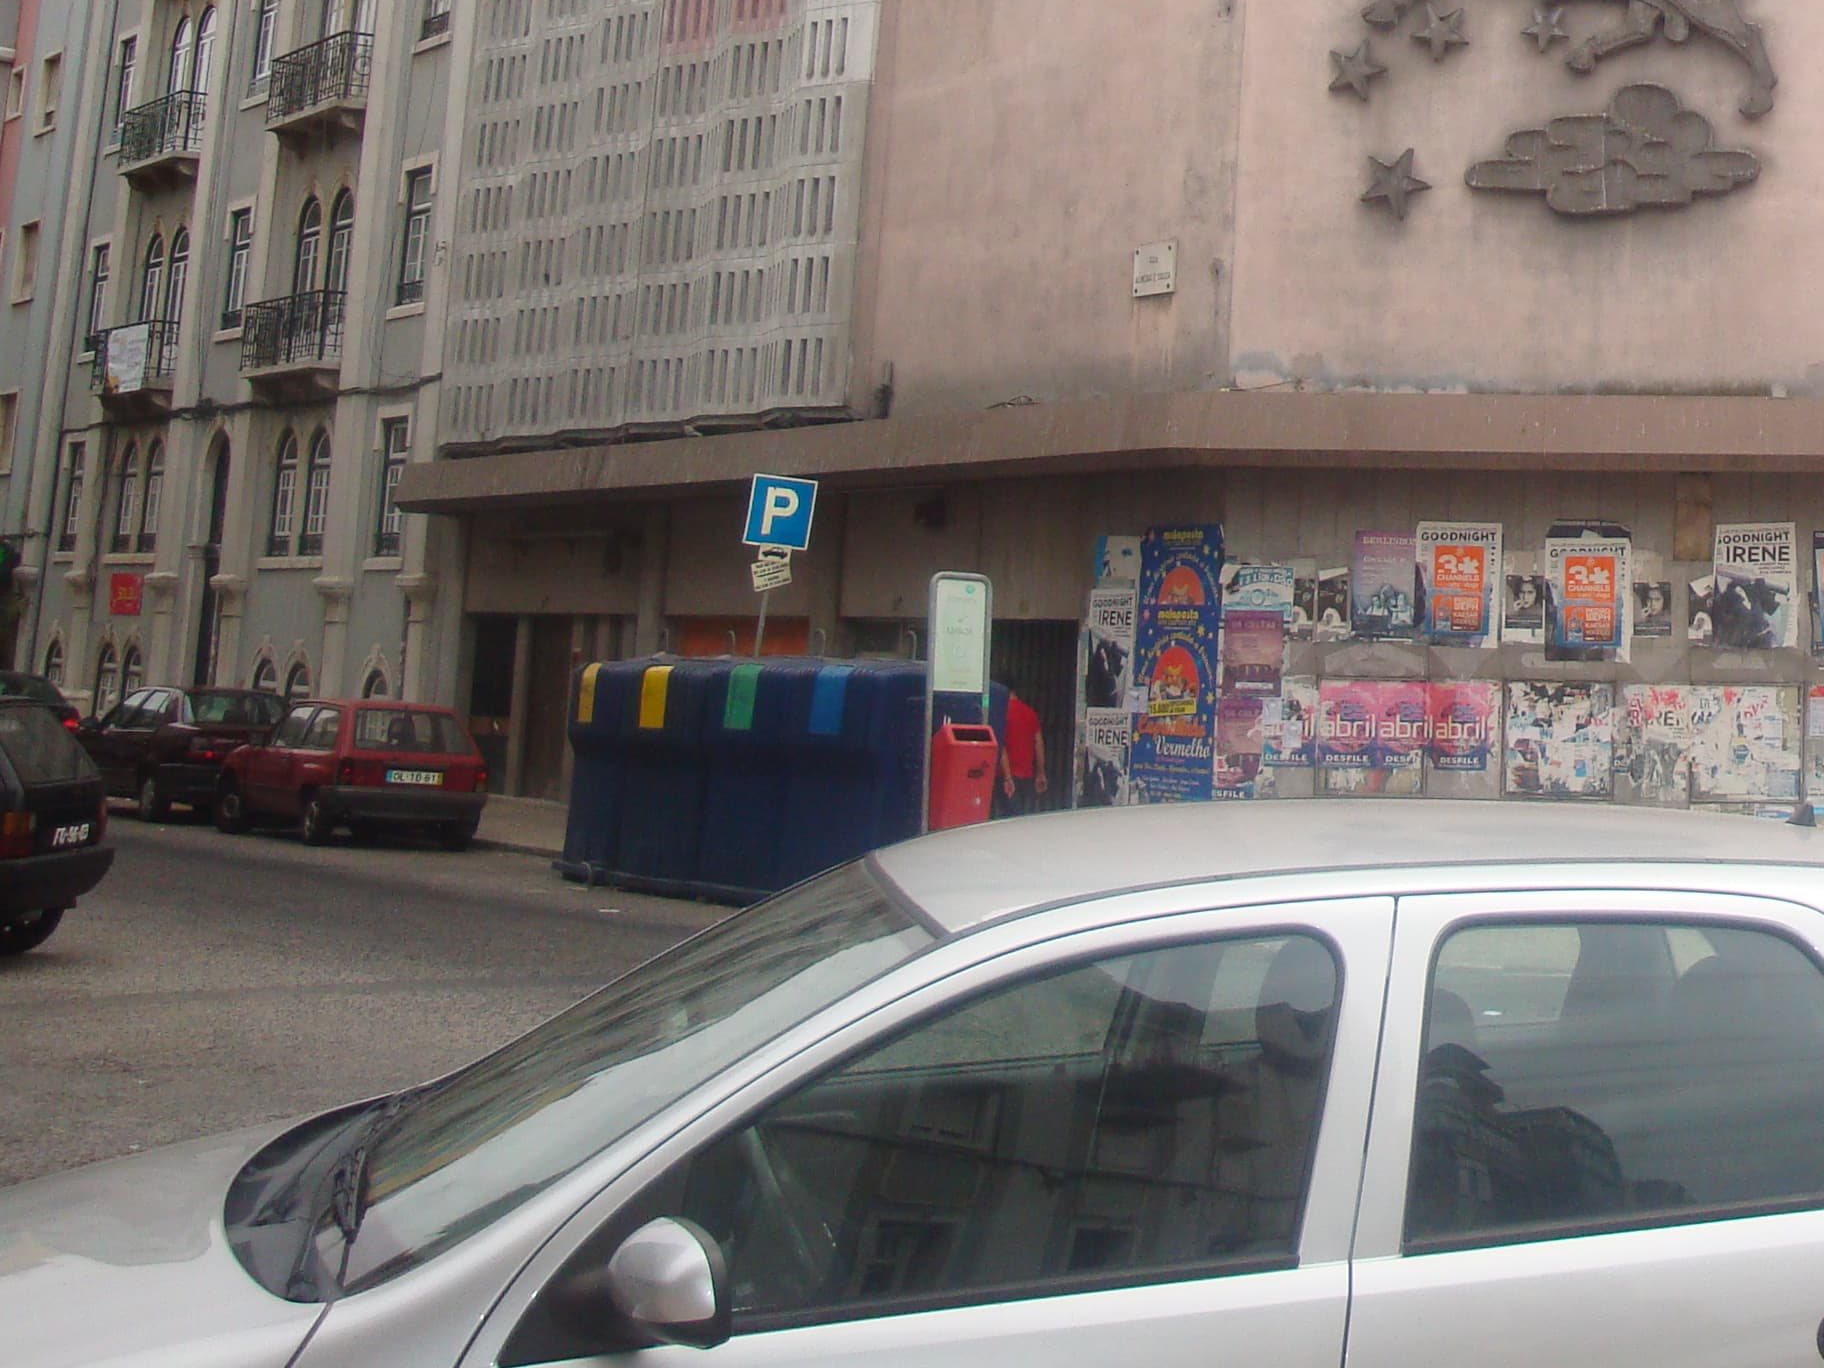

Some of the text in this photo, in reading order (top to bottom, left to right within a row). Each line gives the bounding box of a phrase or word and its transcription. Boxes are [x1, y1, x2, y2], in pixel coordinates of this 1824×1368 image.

[761, 487, 799, 535] P
[1421, 531, 1497, 543] GOODNIGHT
[1726, 545, 1791, 563] IRENE
[1092, 597, 1134, 609] GOODNIGHT
[1098, 610, 1133, 626] IRENE
[1088, 716, 1129, 727] GOODNIGHT
[1320, 714, 1376, 738] abril
[1379, 714, 1433, 739] abril
[1436, 714, 1486, 740] abril
[1094, 728, 1129, 746] IRENE
[1155, 734, 1211, 759] Vermelho
[1264, 752, 1308, 762] DEILE
[1325, 753, 1369, 763] DESFILE
[1439, 756, 1480, 765] DESFILE
